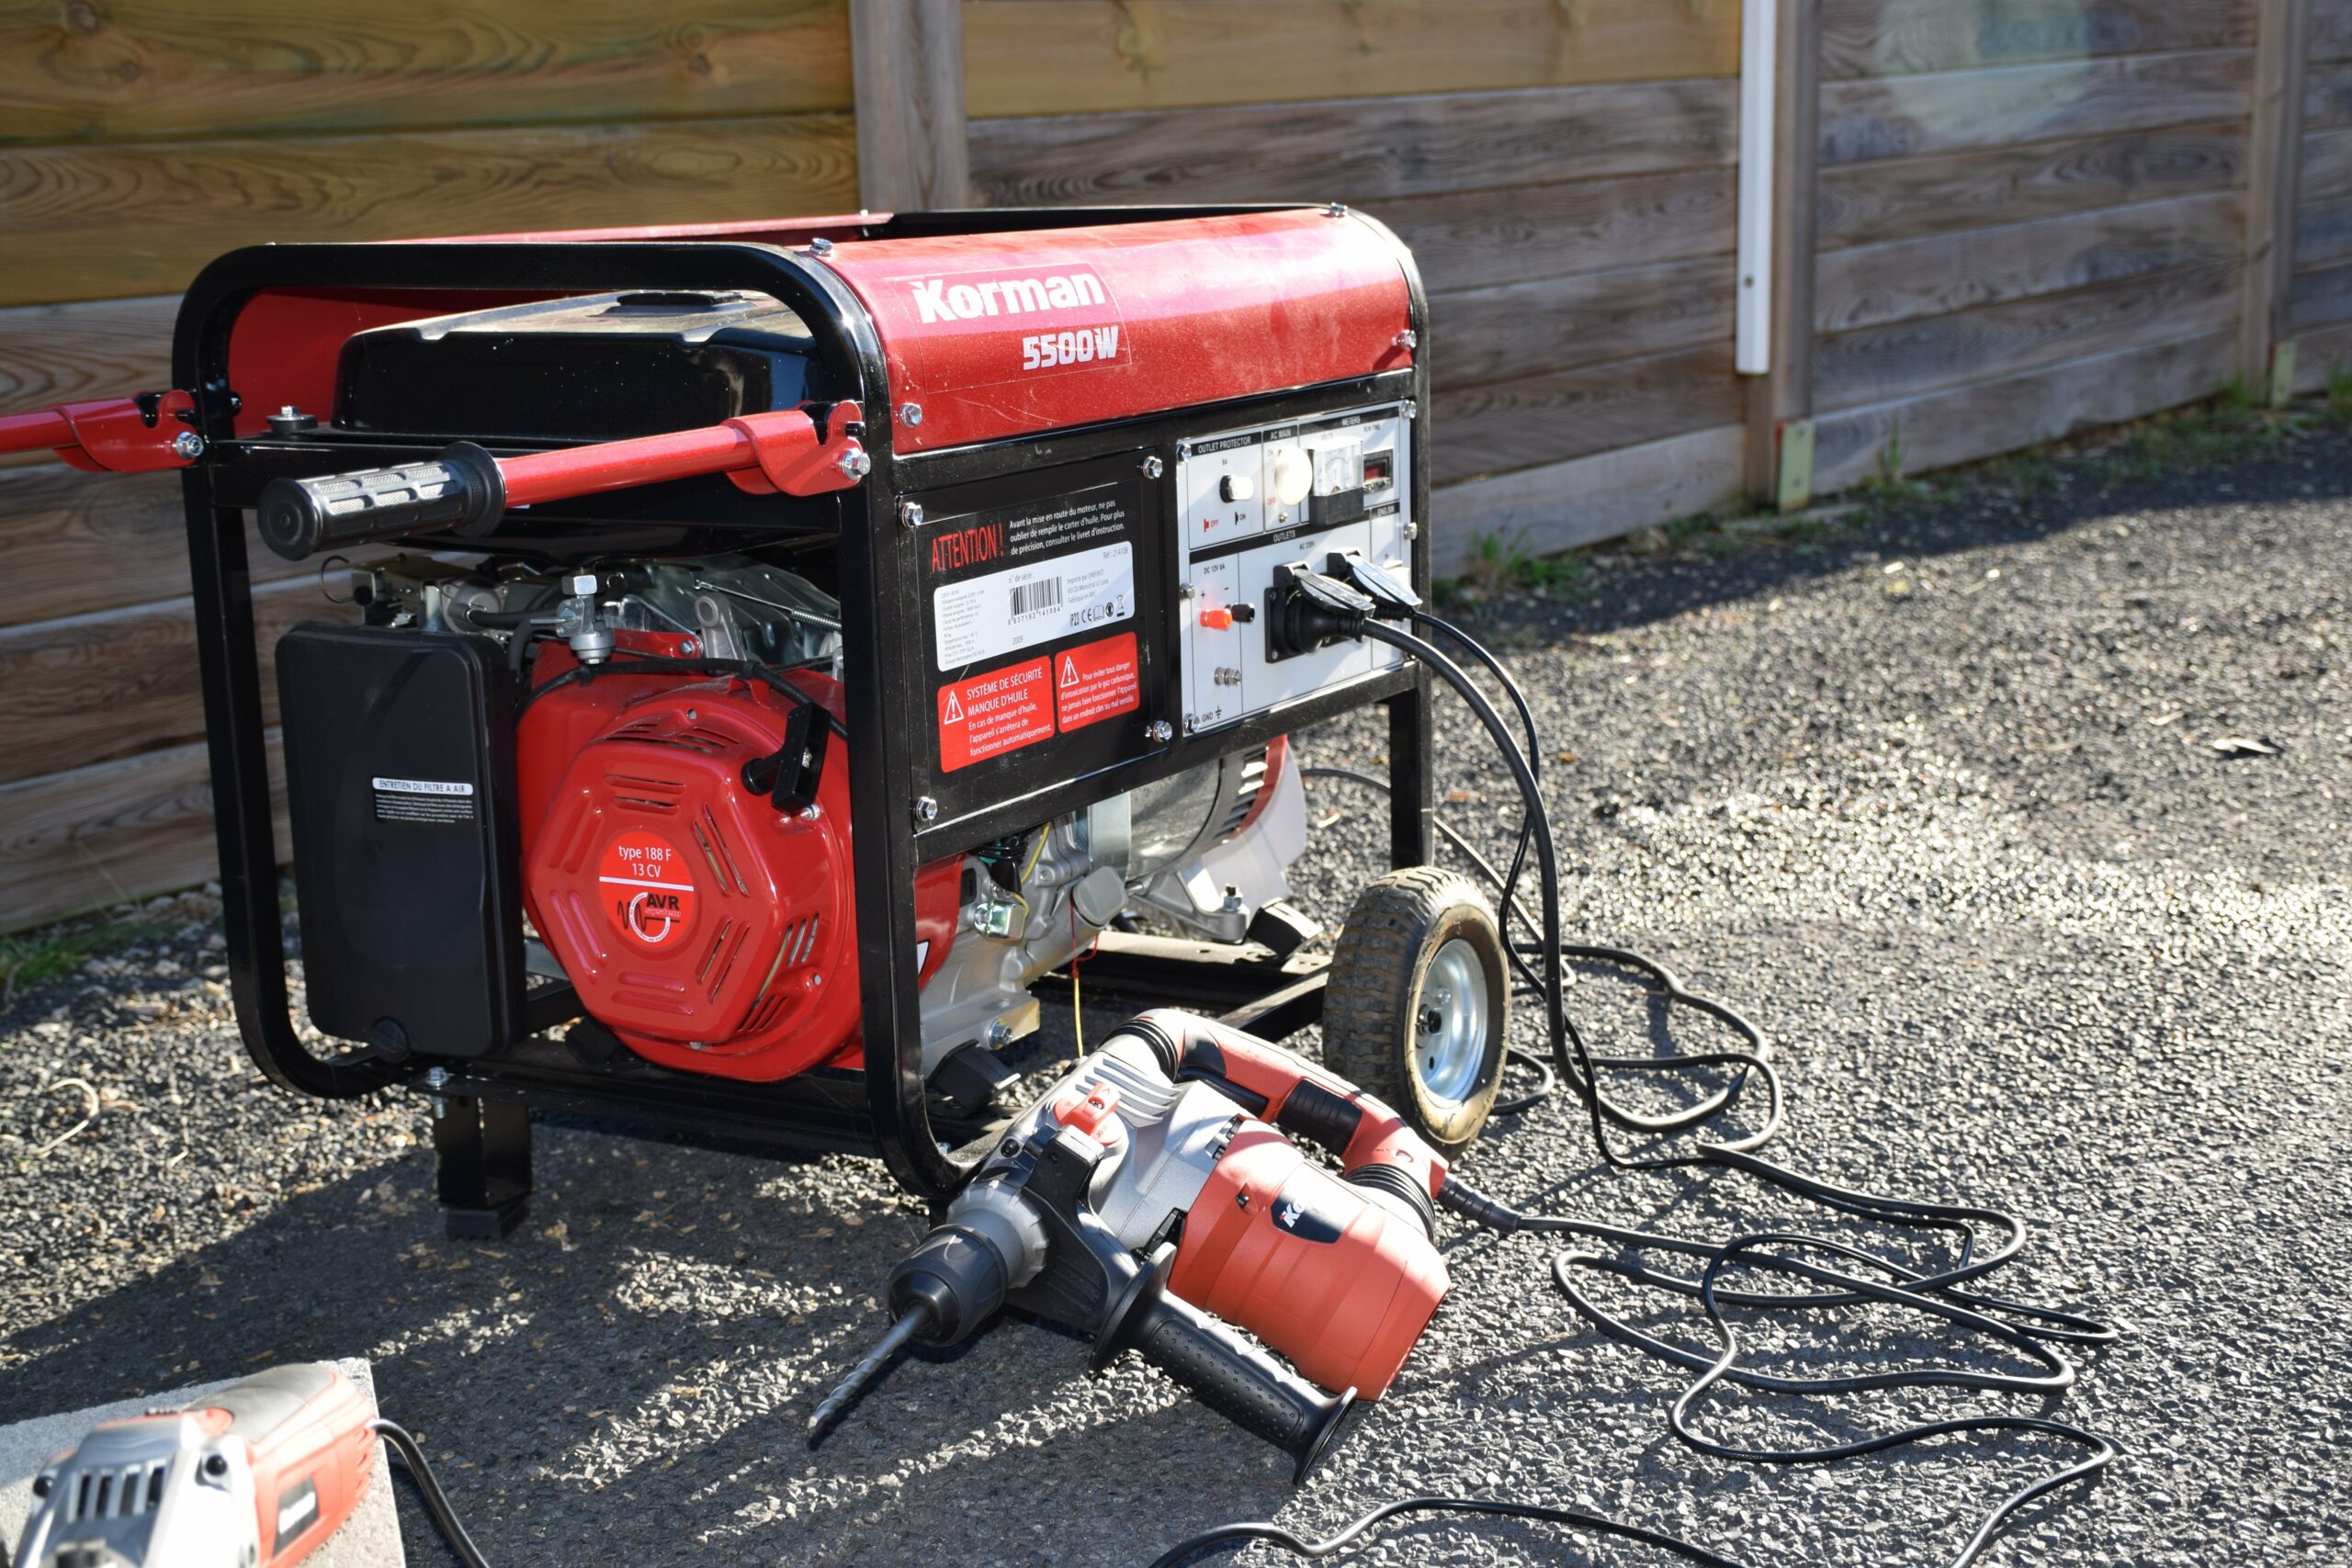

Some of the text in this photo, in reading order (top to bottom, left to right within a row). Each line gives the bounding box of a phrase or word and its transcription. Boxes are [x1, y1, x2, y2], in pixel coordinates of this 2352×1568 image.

[909, 273, 1106, 324] Korman
[1023, 325, 1119, 371] 5500W
[1270, 429, 1292, 440] AC MAIN
[1198, 436, 1251, 454] OUTLET PROTECTOR
[1010, 519, 1025, 529] Avant
[1026, 516, 1031, 525] la
[1033, 514, 1045, 524] mise
[1054, 511, 1068, 519] route
[1069, 507, 1076, 516] du
[1077, 504, 1098, 514] moteur,
[1106, 500, 1115, 510] pas
[1011, 510, 1125, 542] oublier de remplir le carter d'huile. Pour plus
[1210, 519, 1219, 527] OFF
[1011, 523, 1125, 556] de précision, consulter le livret d'instruction.
[1273, 529, 1296, 542] OUTLETS
[932, 525, 998, 573] ATTENTION
[1204, 567, 1210, 575] DC
[967, 666, 1042, 700] SYSTÈME DE SÉCURITÉ
[1082, 673, 1093, 682] Pour
[967, 688, 1028, 716] MANQUE D'HUILE
[1068, 700, 1082, 712] jamais
[968, 721, 976, 731] En
[987, 716, 994, 725] de
[994, 709, 1017, 722] manque
[1022, 717, 1029, 727] de
[1062, 715, 1073, 724] dans
[1202, 712, 1213, 722] GND
[970, 740, 1002, 757] fonctionner
[379, 780, 411, 790] ENTRETIEN
[413, 783, 423, 791] DU
[424, 784, 444, 792] FILTRE
[618, 845, 672, 862] type 188 F
[632, 863, 661, 878] 13 CV
[647, 894, 680, 910] AVR
